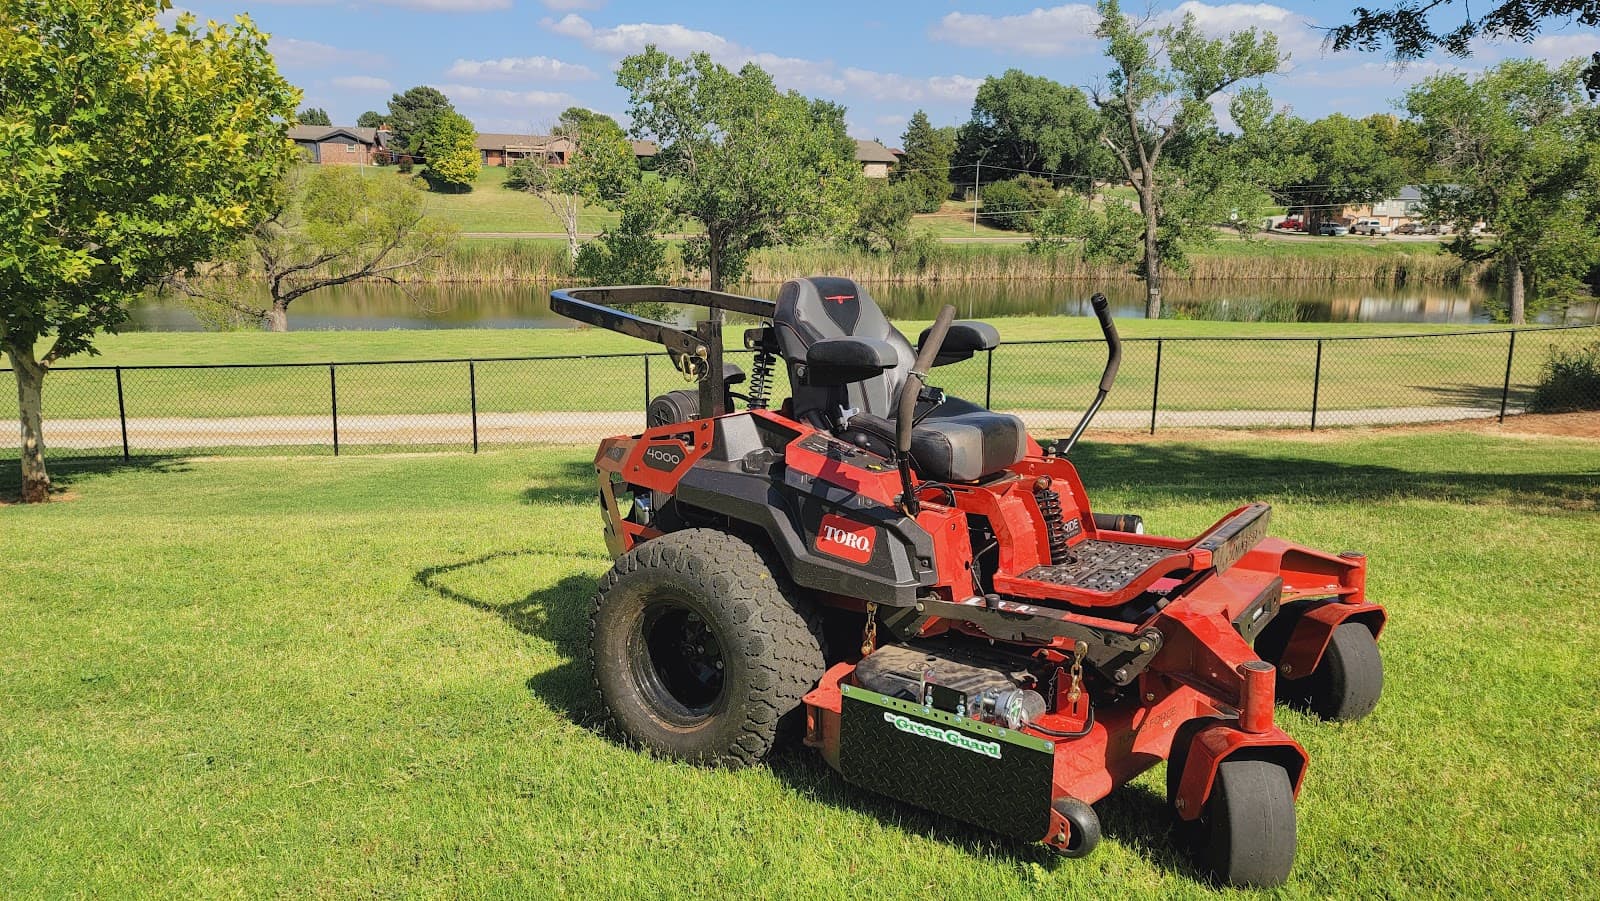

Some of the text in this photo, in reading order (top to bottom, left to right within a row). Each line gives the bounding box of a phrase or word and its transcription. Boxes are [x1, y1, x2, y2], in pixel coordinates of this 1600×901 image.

[647, 448, 680, 464] 4000
[824, 525, 870, 551] TORO
[896, 719, 943, 738] Green
[946, 733, 998, 755] Guard
